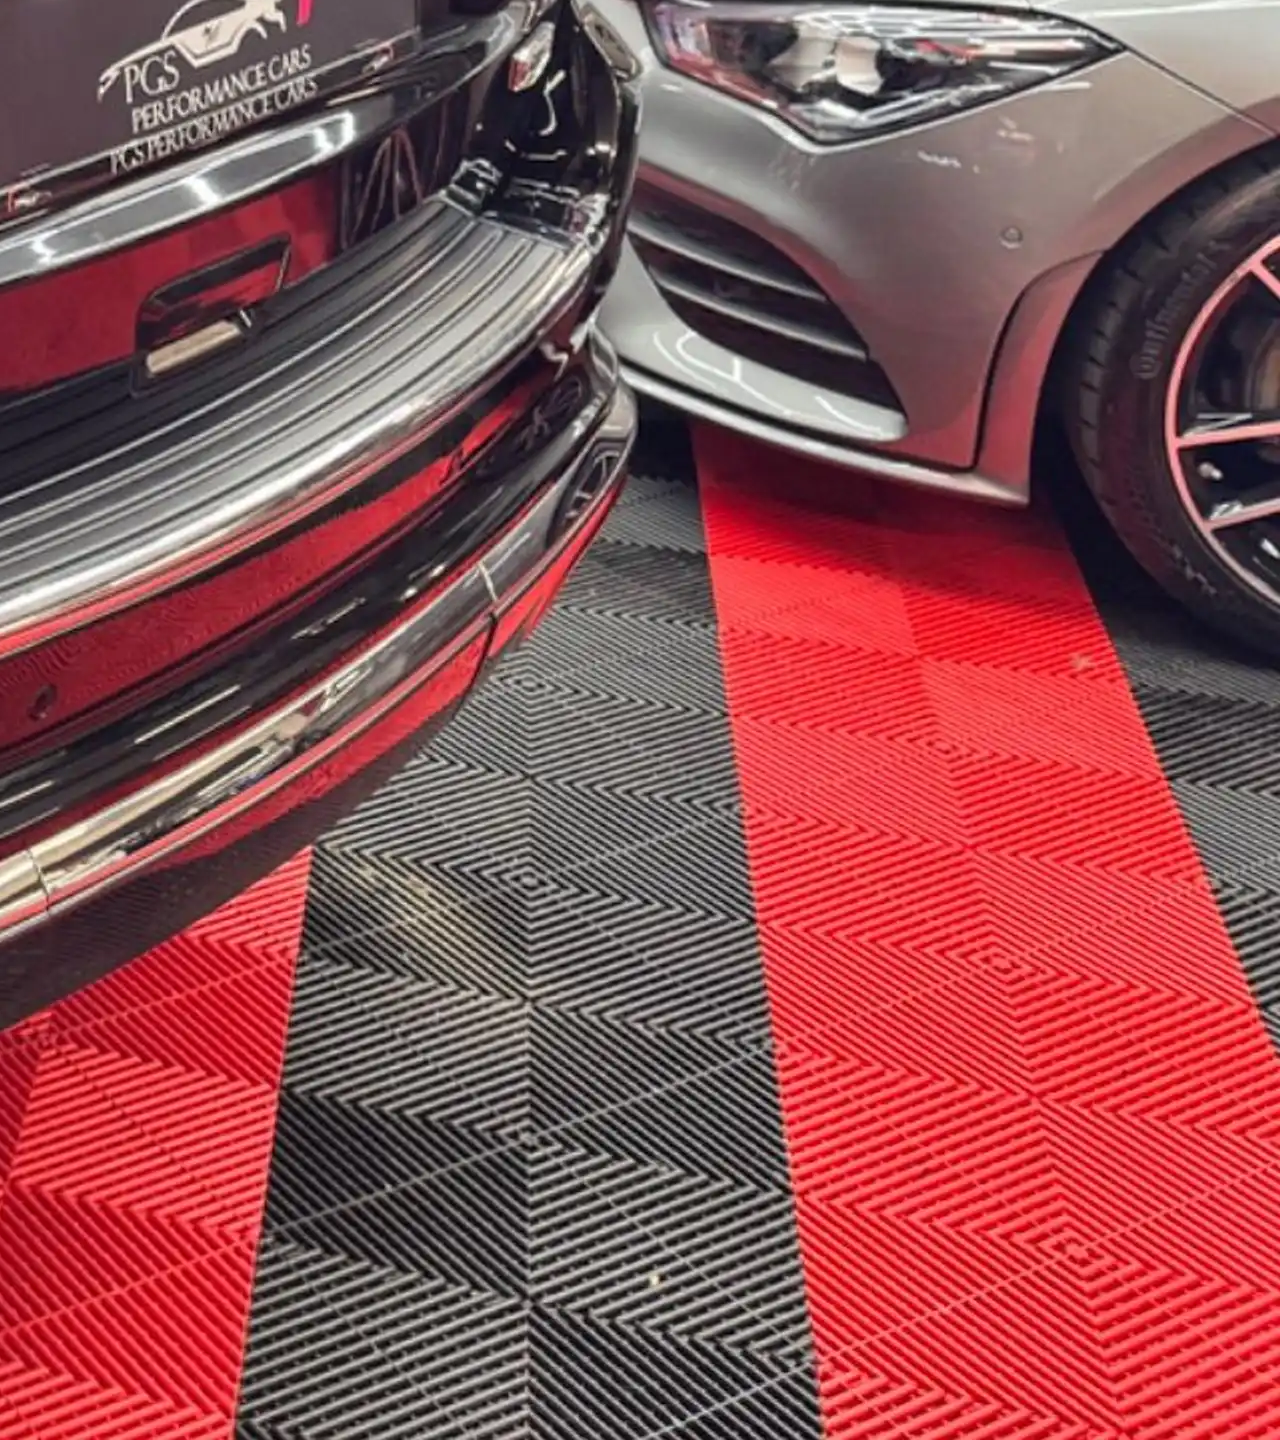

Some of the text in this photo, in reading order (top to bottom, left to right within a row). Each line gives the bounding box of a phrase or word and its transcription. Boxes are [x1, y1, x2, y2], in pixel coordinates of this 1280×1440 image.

[124, 49, 180, 105] PGS
[131, 43, 313, 135] PERFORMANCE CARS
[109, 76, 319, 175] PGS PERFORMANCE CARS
